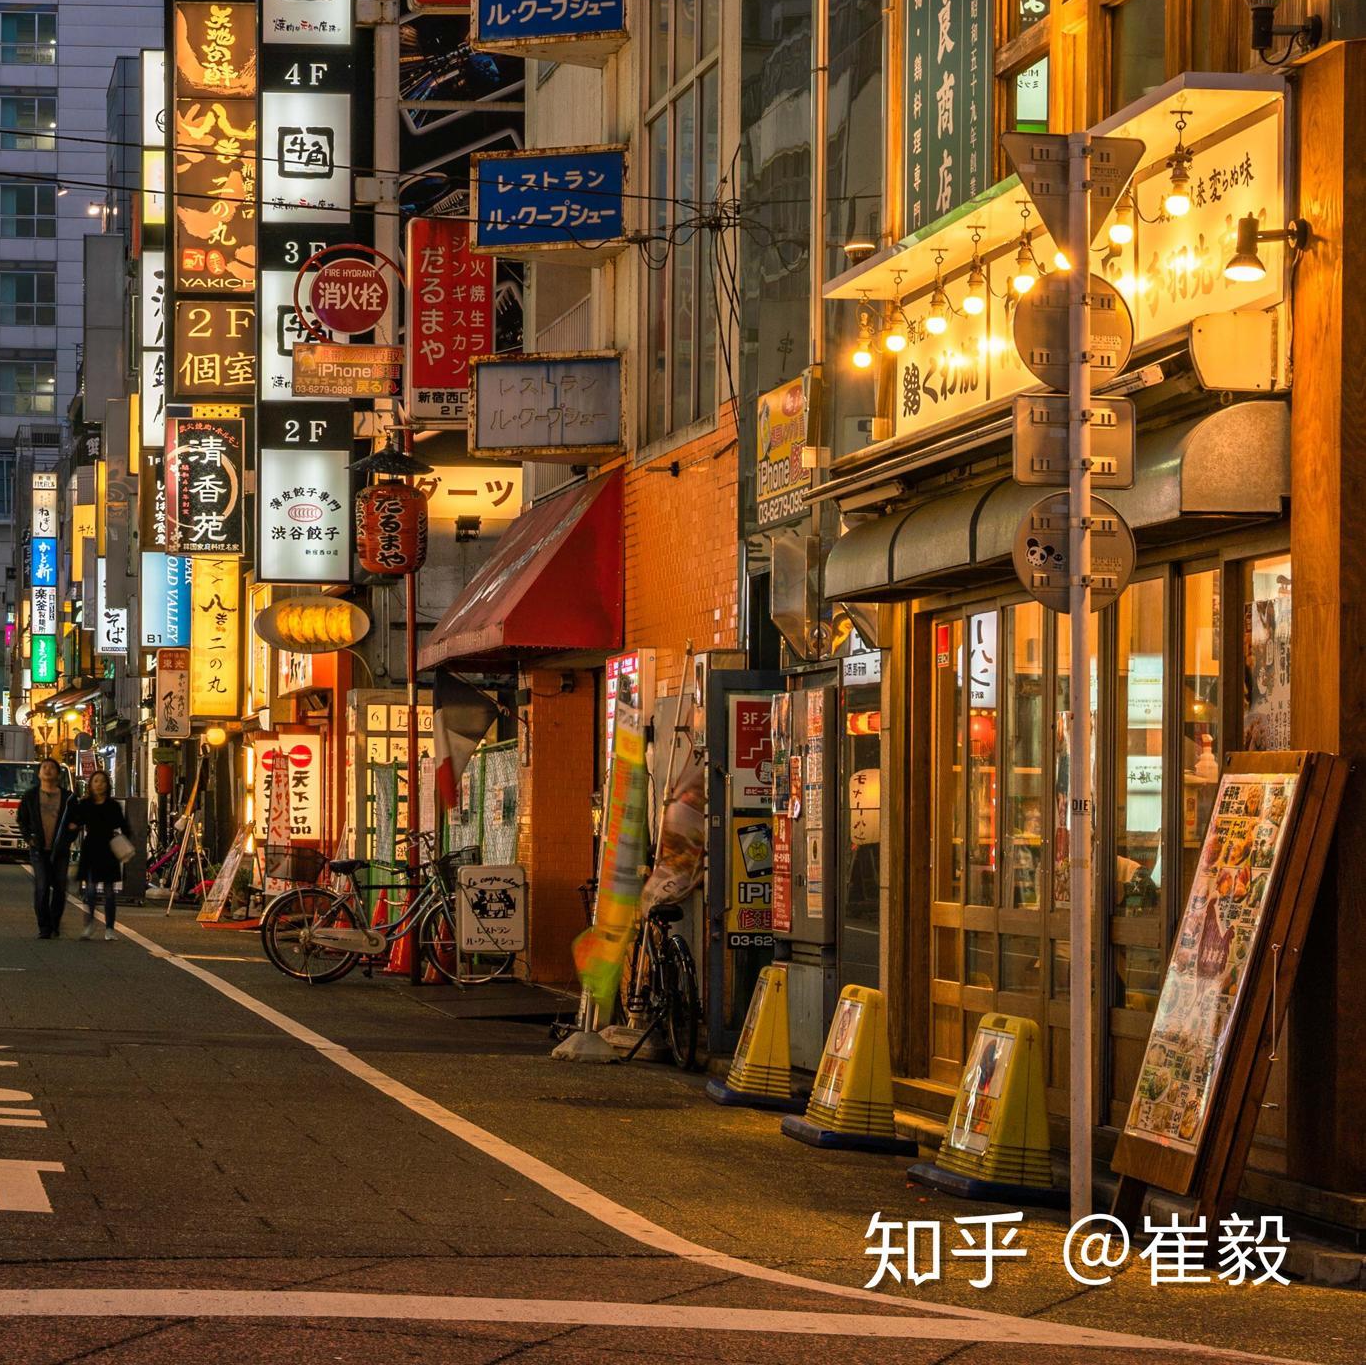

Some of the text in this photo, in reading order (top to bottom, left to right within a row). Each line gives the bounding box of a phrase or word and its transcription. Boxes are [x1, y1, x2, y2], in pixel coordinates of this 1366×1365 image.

[285, 63, 328, 85] 4F
[497, 170, 605, 194] レストラン
[324, 269, 376, 278] FIRE HYDRANT
[318, 283, 383, 311] 消火栓
[420, 248, 445, 365] だるまや
[452, 236, 468, 374] ジンギスカン
[187, 308, 255, 338] 2F
[179, 352, 256, 386] 個室
[318, 363, 371, 377] iPhone
[295, 384, 353, 395] 03-6279-0998
[440, 406, 465, 416] 2F
[285, 420, 327, 442] 2F
[189, 436, 227, 542] 清香苑
[271, 525, 340, 541] 渋谷餃子
[166, 556, 179, 644] OLD VALLEY
[147, 634, 163, 644] B1
[207, 637, 227, 694] 二の丸
